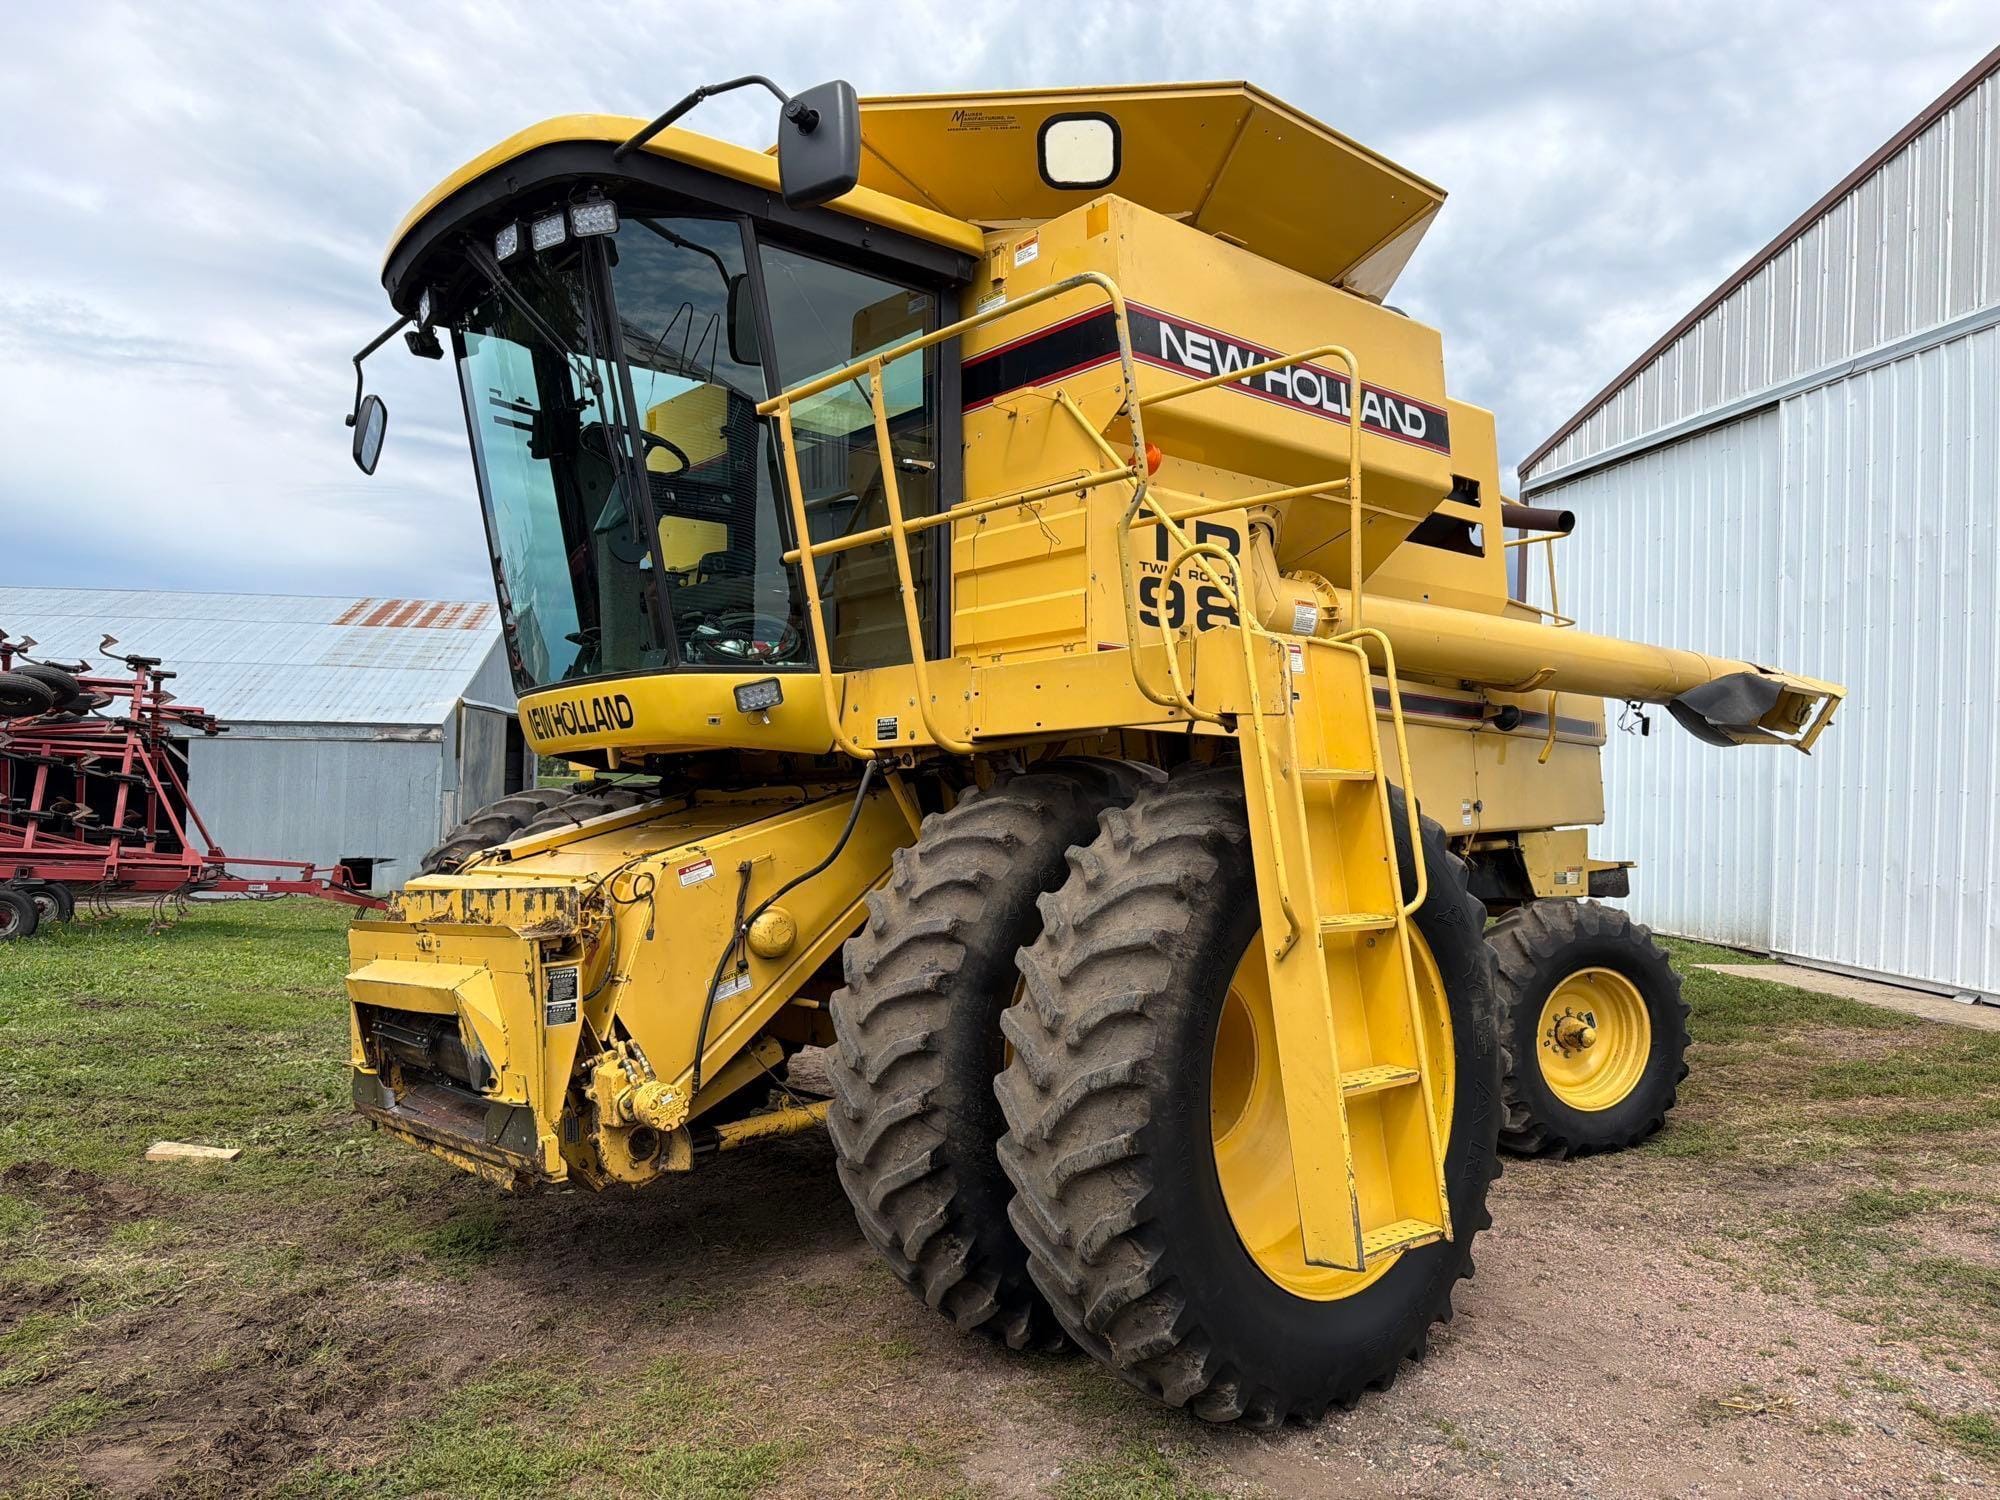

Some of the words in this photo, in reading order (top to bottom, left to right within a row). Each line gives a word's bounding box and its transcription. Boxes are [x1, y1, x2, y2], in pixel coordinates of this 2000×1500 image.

[1159, 321, 1254, 386] NEW
[1263, 357, 1427, 439] HOLLAND
[1139, 561, 1181, 577] TWN
[1139, 576, 1241, 632] 98
[527, 705, 556, 741] NEW
[549, 694, 634, 736] HOLLAND
